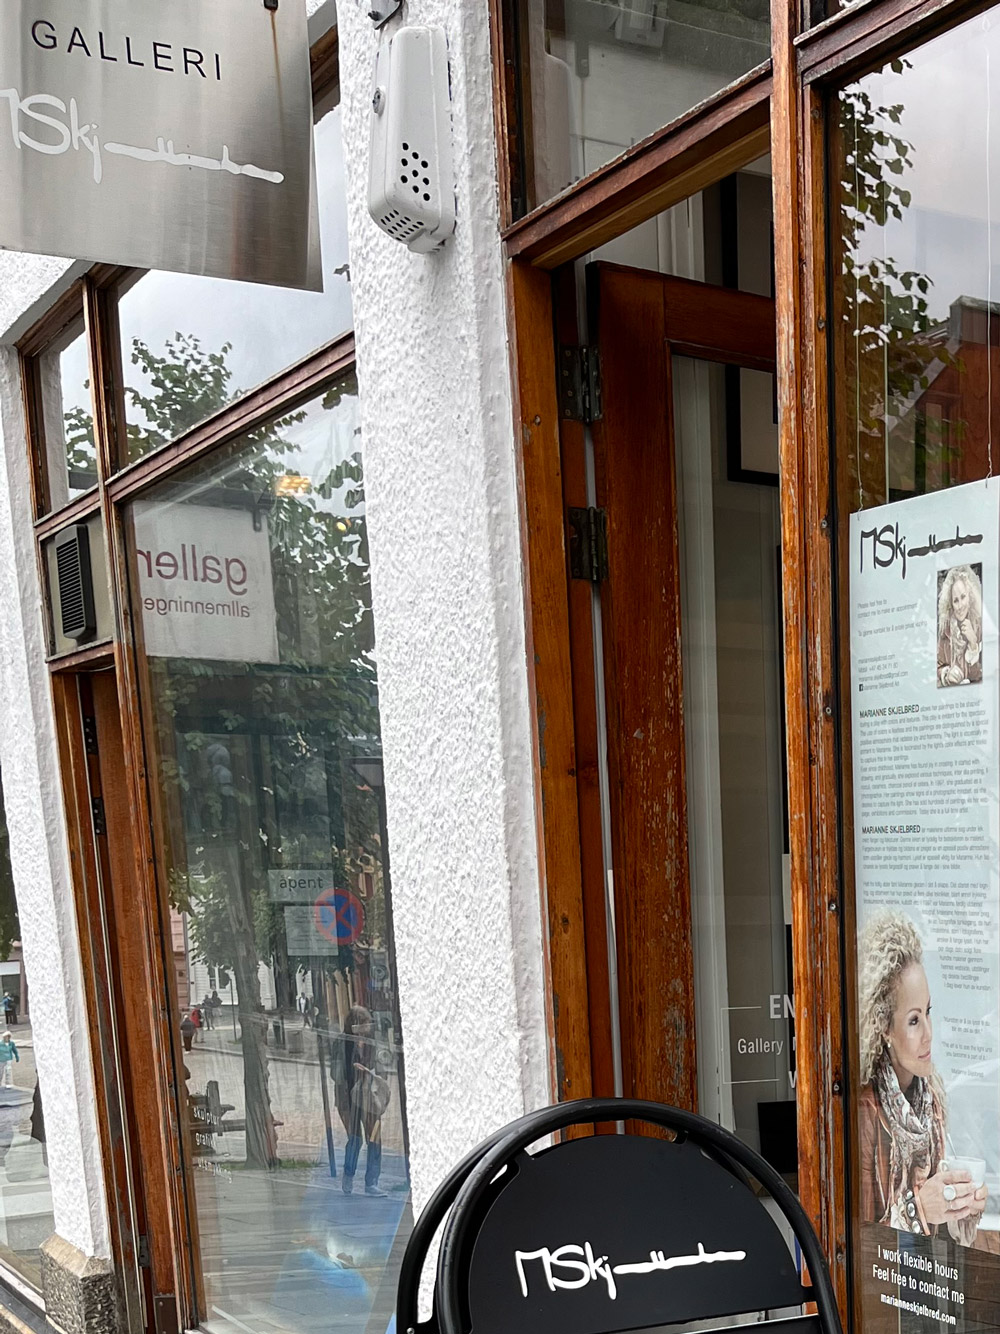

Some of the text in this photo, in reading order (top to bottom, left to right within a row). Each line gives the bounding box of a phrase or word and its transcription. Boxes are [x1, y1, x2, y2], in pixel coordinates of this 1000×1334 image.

[31, 20, 221, 80] GALLERI
[860, 707, 887, 718] MARIANNE
[887, 704, 920, 716] SKJELBRED
[862, 826, 888, 835] MARIANNE
[889, 824, 921, 834] SKJELBRED
[737, 1038, 784, 1055] Gallery
[877, 1244, 959, 1281] I work flexible hours
[872, 1264, 965, 1305] Feel free to contact me
[880, 1293, 957, 1326] marianneskjelbred.com
